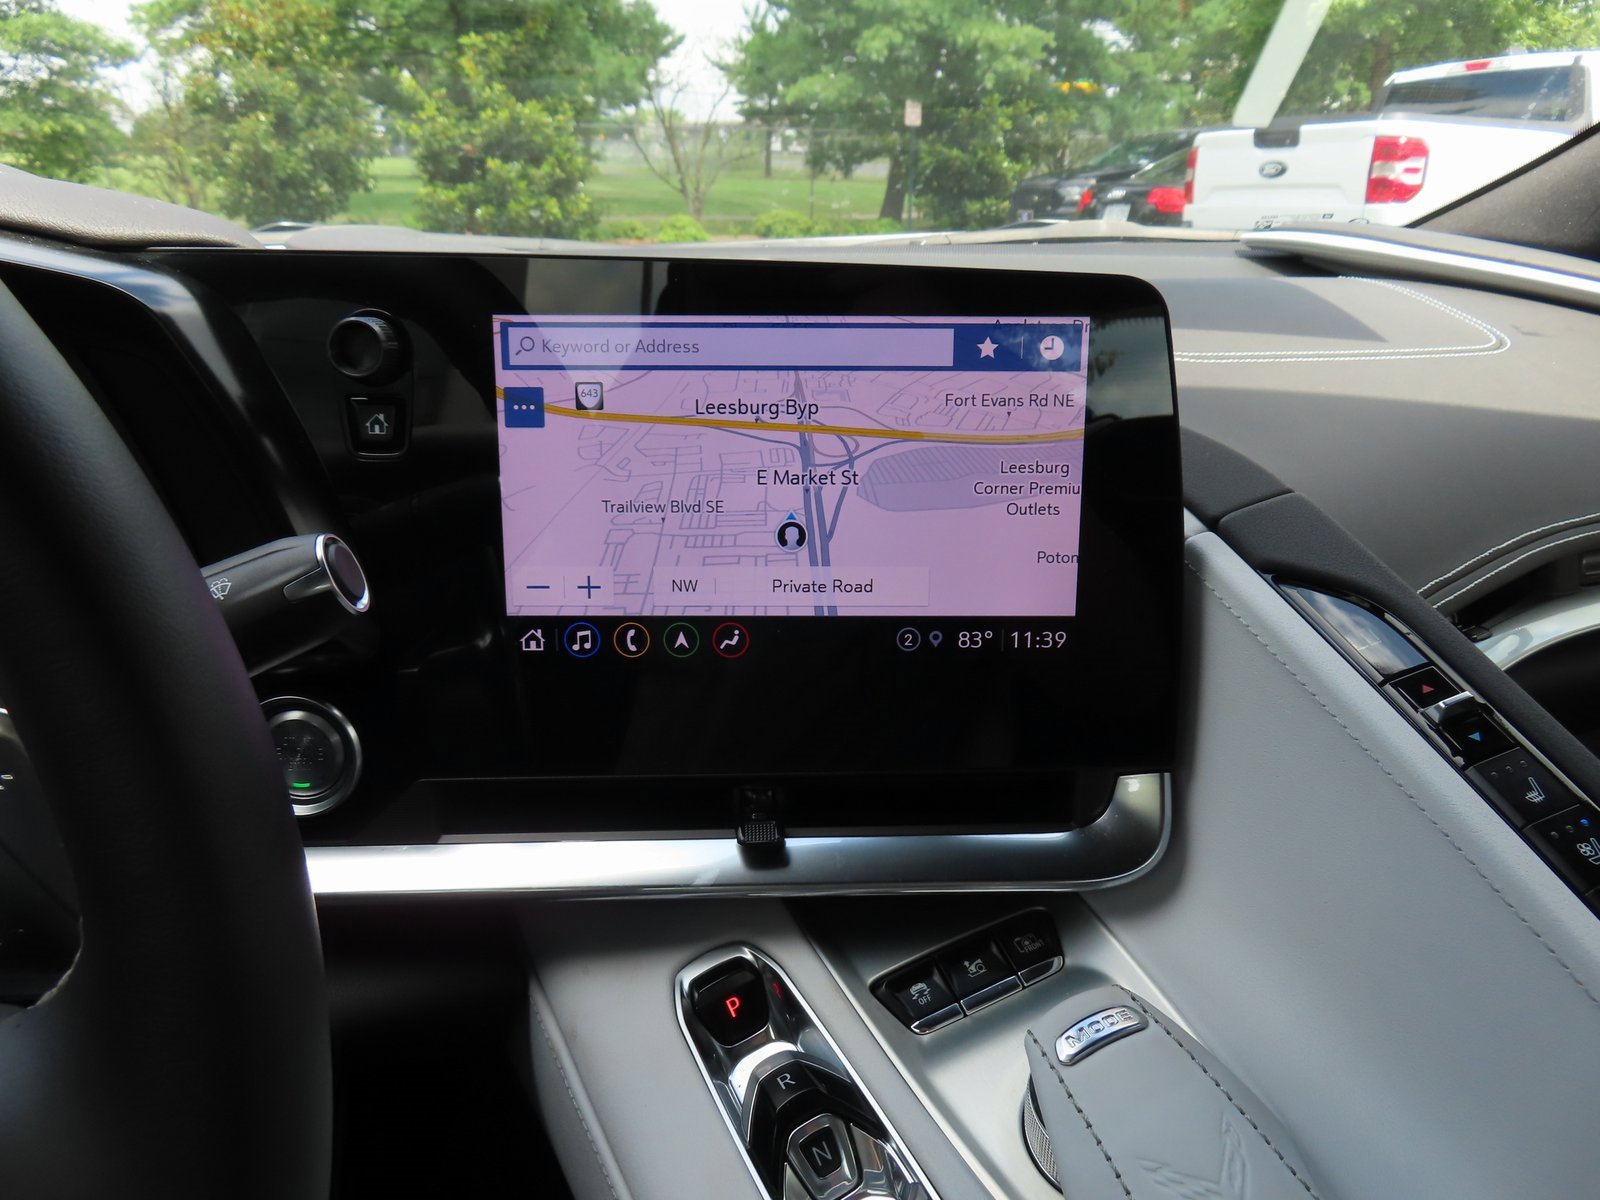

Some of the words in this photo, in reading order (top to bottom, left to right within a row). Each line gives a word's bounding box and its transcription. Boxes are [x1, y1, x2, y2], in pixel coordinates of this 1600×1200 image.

[541, 338, 610, 355] Keyword
[614, 342, 632, 353] or
[635, 339, 700, 353] Address
[580, 388, 599, 399] 643
[945, 393, 976, 407] Fort
[981, 394, 1024, 408] Evans
[1030, 393, 1048, 408] Rd
[1053, 394, 1075, 408] NE
[695, 398, 780, 419] Leesburg
[785, 400, 819, 419] Byp
[1000, 461, 1070, 478] Leesburg
[757, 470, 767, 485] E
[773, 470, 836, 486] Market
[841, 471, 859, 485] St
[973, 482, 1024, 495] Corner
[601, 500, 666, 514] Trailview
[670, 500, 701, 514] Blvd
[706, 501, 724, 514] SE
[1006, 502, 1060, 516] Outlets
[671, 579, 699, 593] NW
[772, 578, 827, 593] Private
[832, 579, 874, 593] Road
[904, 633, 913, 646] 2
[957, 630, 993, 649] 83°
[1010, 631, 1068, 649] 11:39
[724, 997, 741, 1018] P
[917, 994, 933, 1006] OFF
[1064, 1009, 1134, 1049] MODE
[776, 1072, 795, 1091] R
[811, 1140, 831, 1168] N
